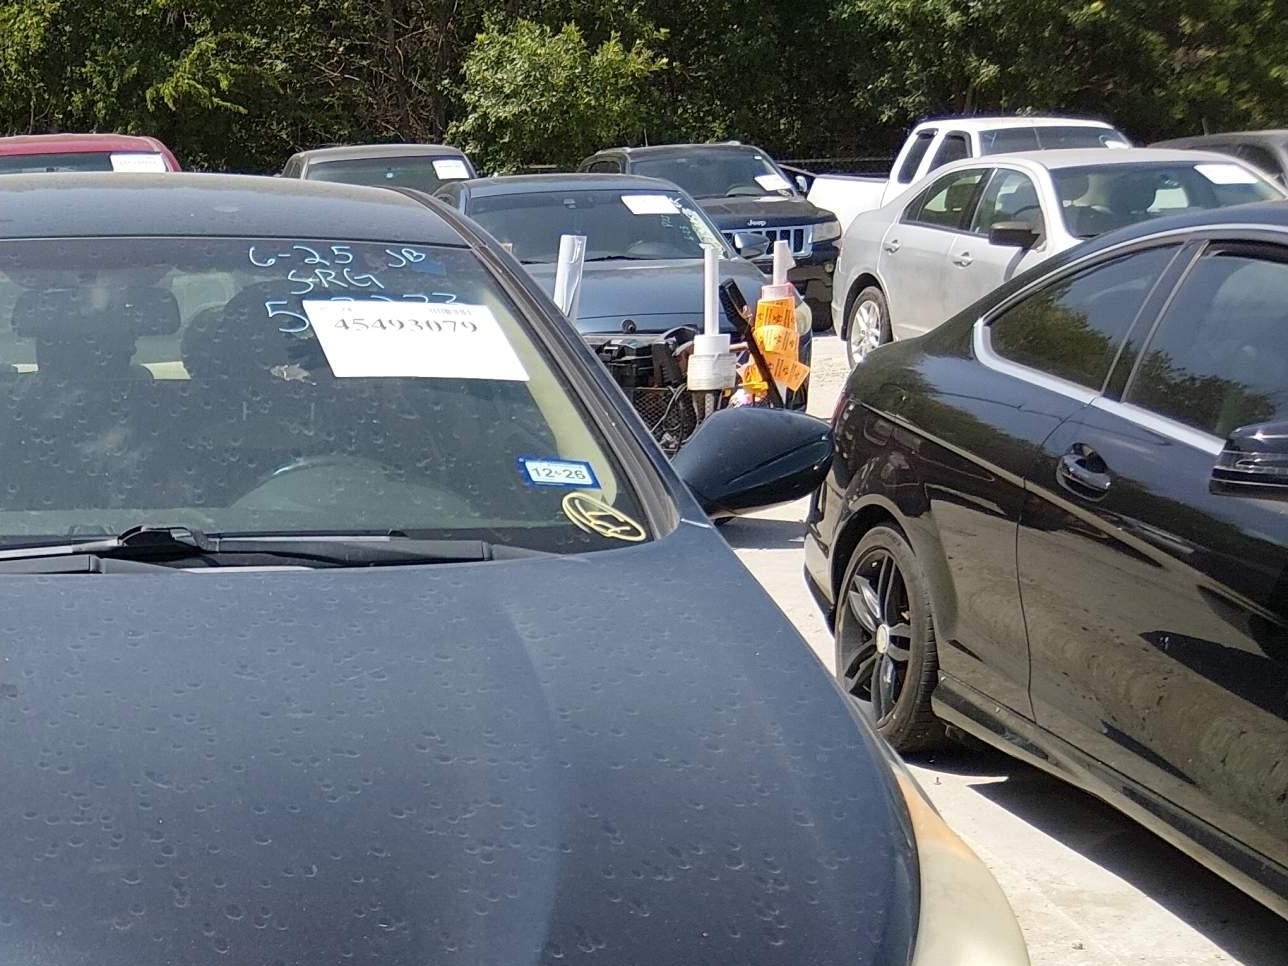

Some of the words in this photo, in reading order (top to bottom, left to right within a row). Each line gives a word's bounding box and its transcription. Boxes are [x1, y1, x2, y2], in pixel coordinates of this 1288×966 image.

[747, 219, 767, 227] Jeep
[249, 246, 353, 267] 6-25
[334, 317, 478, 334] 45493079
